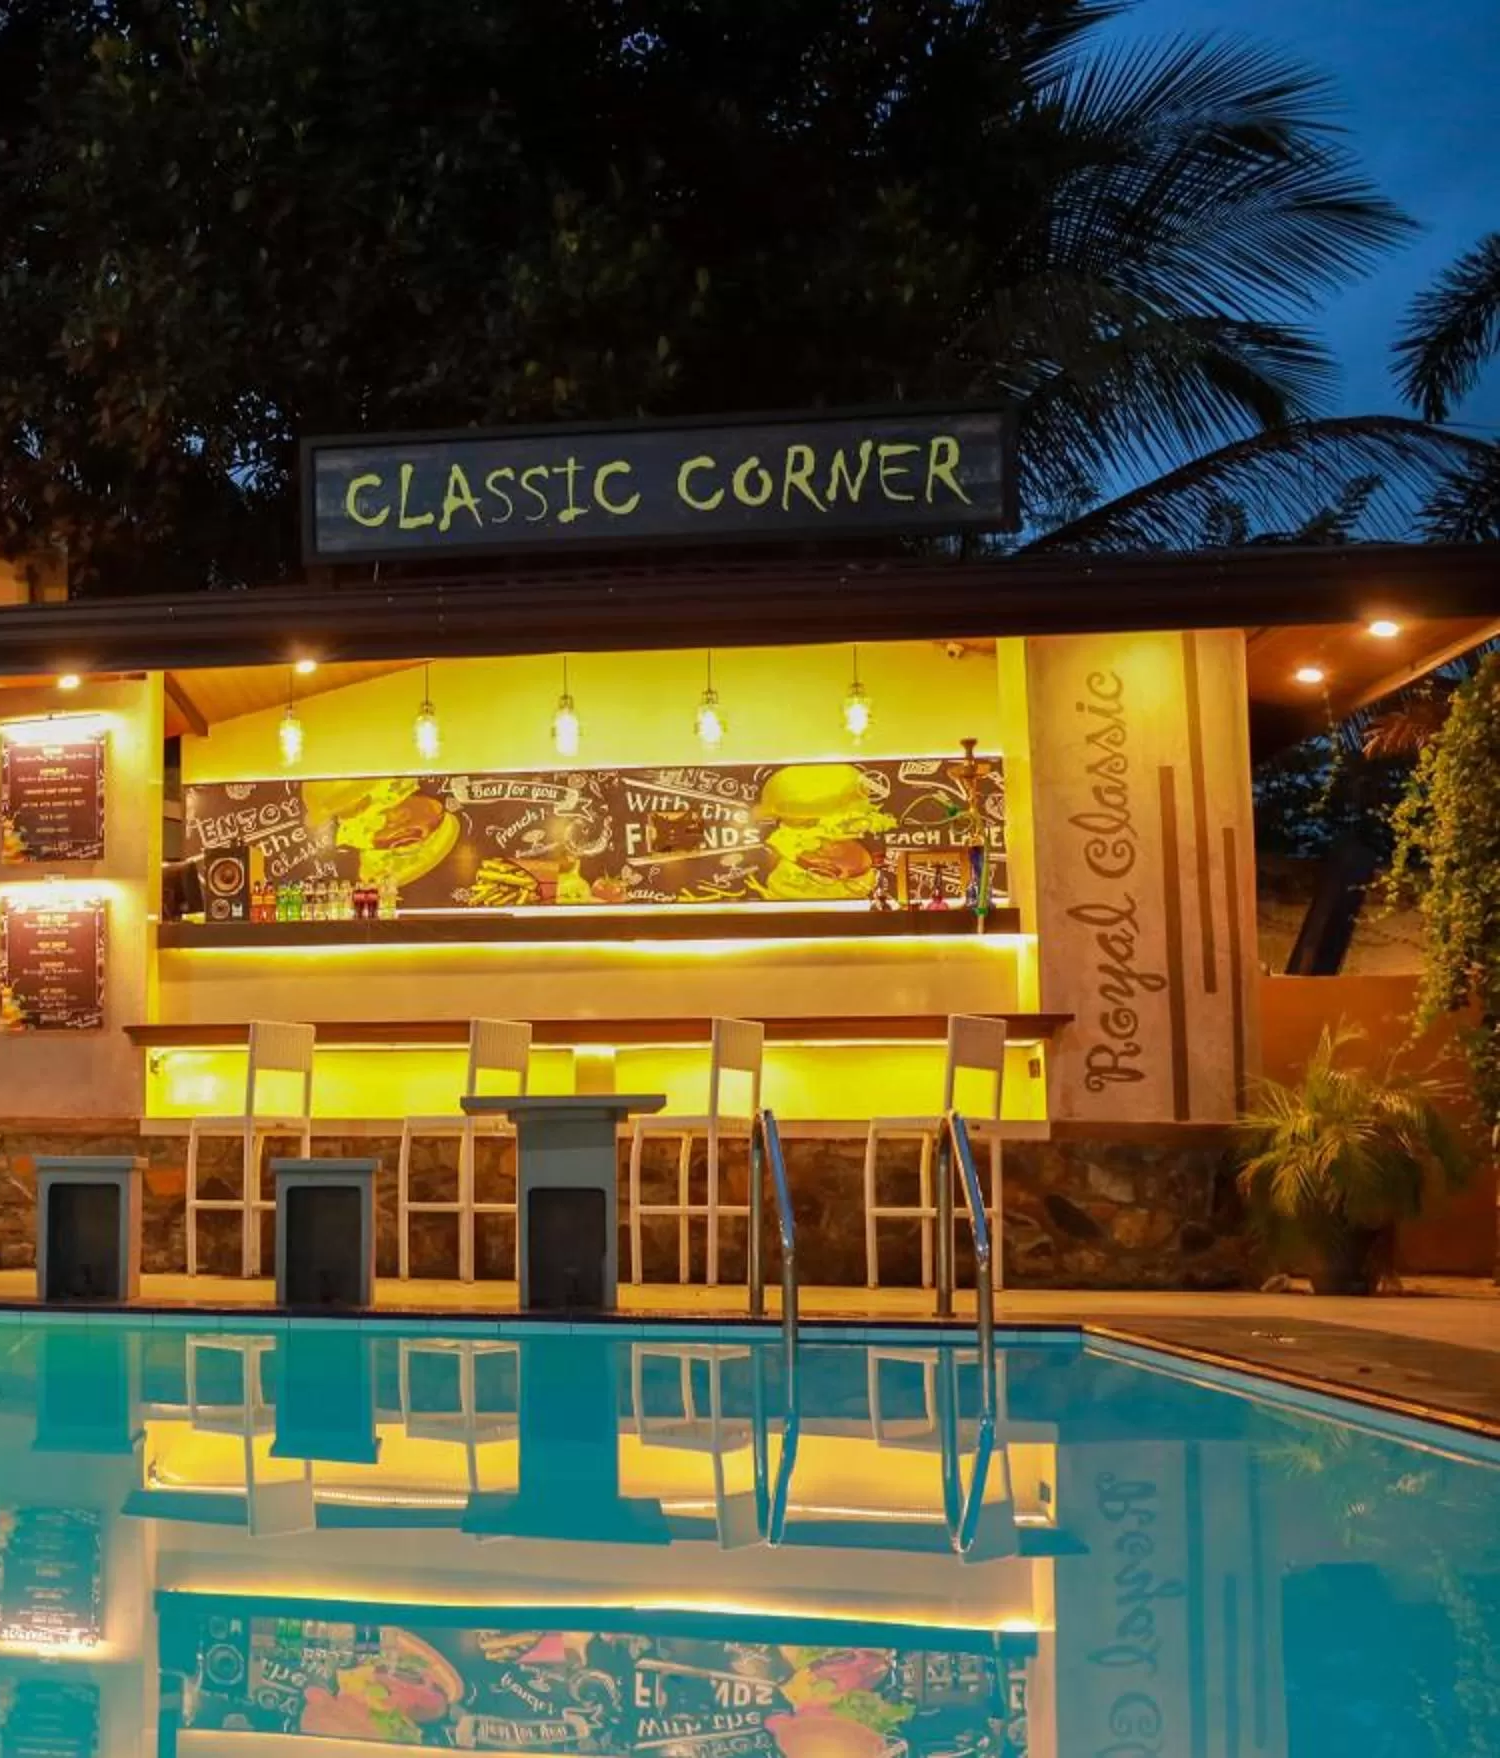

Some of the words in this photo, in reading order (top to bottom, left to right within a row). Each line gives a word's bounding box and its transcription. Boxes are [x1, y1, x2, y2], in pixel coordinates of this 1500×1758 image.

[344, 456, 641, 532] CLASSIC
[677, 435, 973, 514] CORNER
[504, 779, 529, 800] for
[531, 786, 558, 801] you
[1067, 671, 1140, 880] Classic
[702, 803, 750, 824] the
[258, 827, 307, 857] the
[884, 829, 941, 845] EACH
[1065, 892, 1167, 1093] Royal
